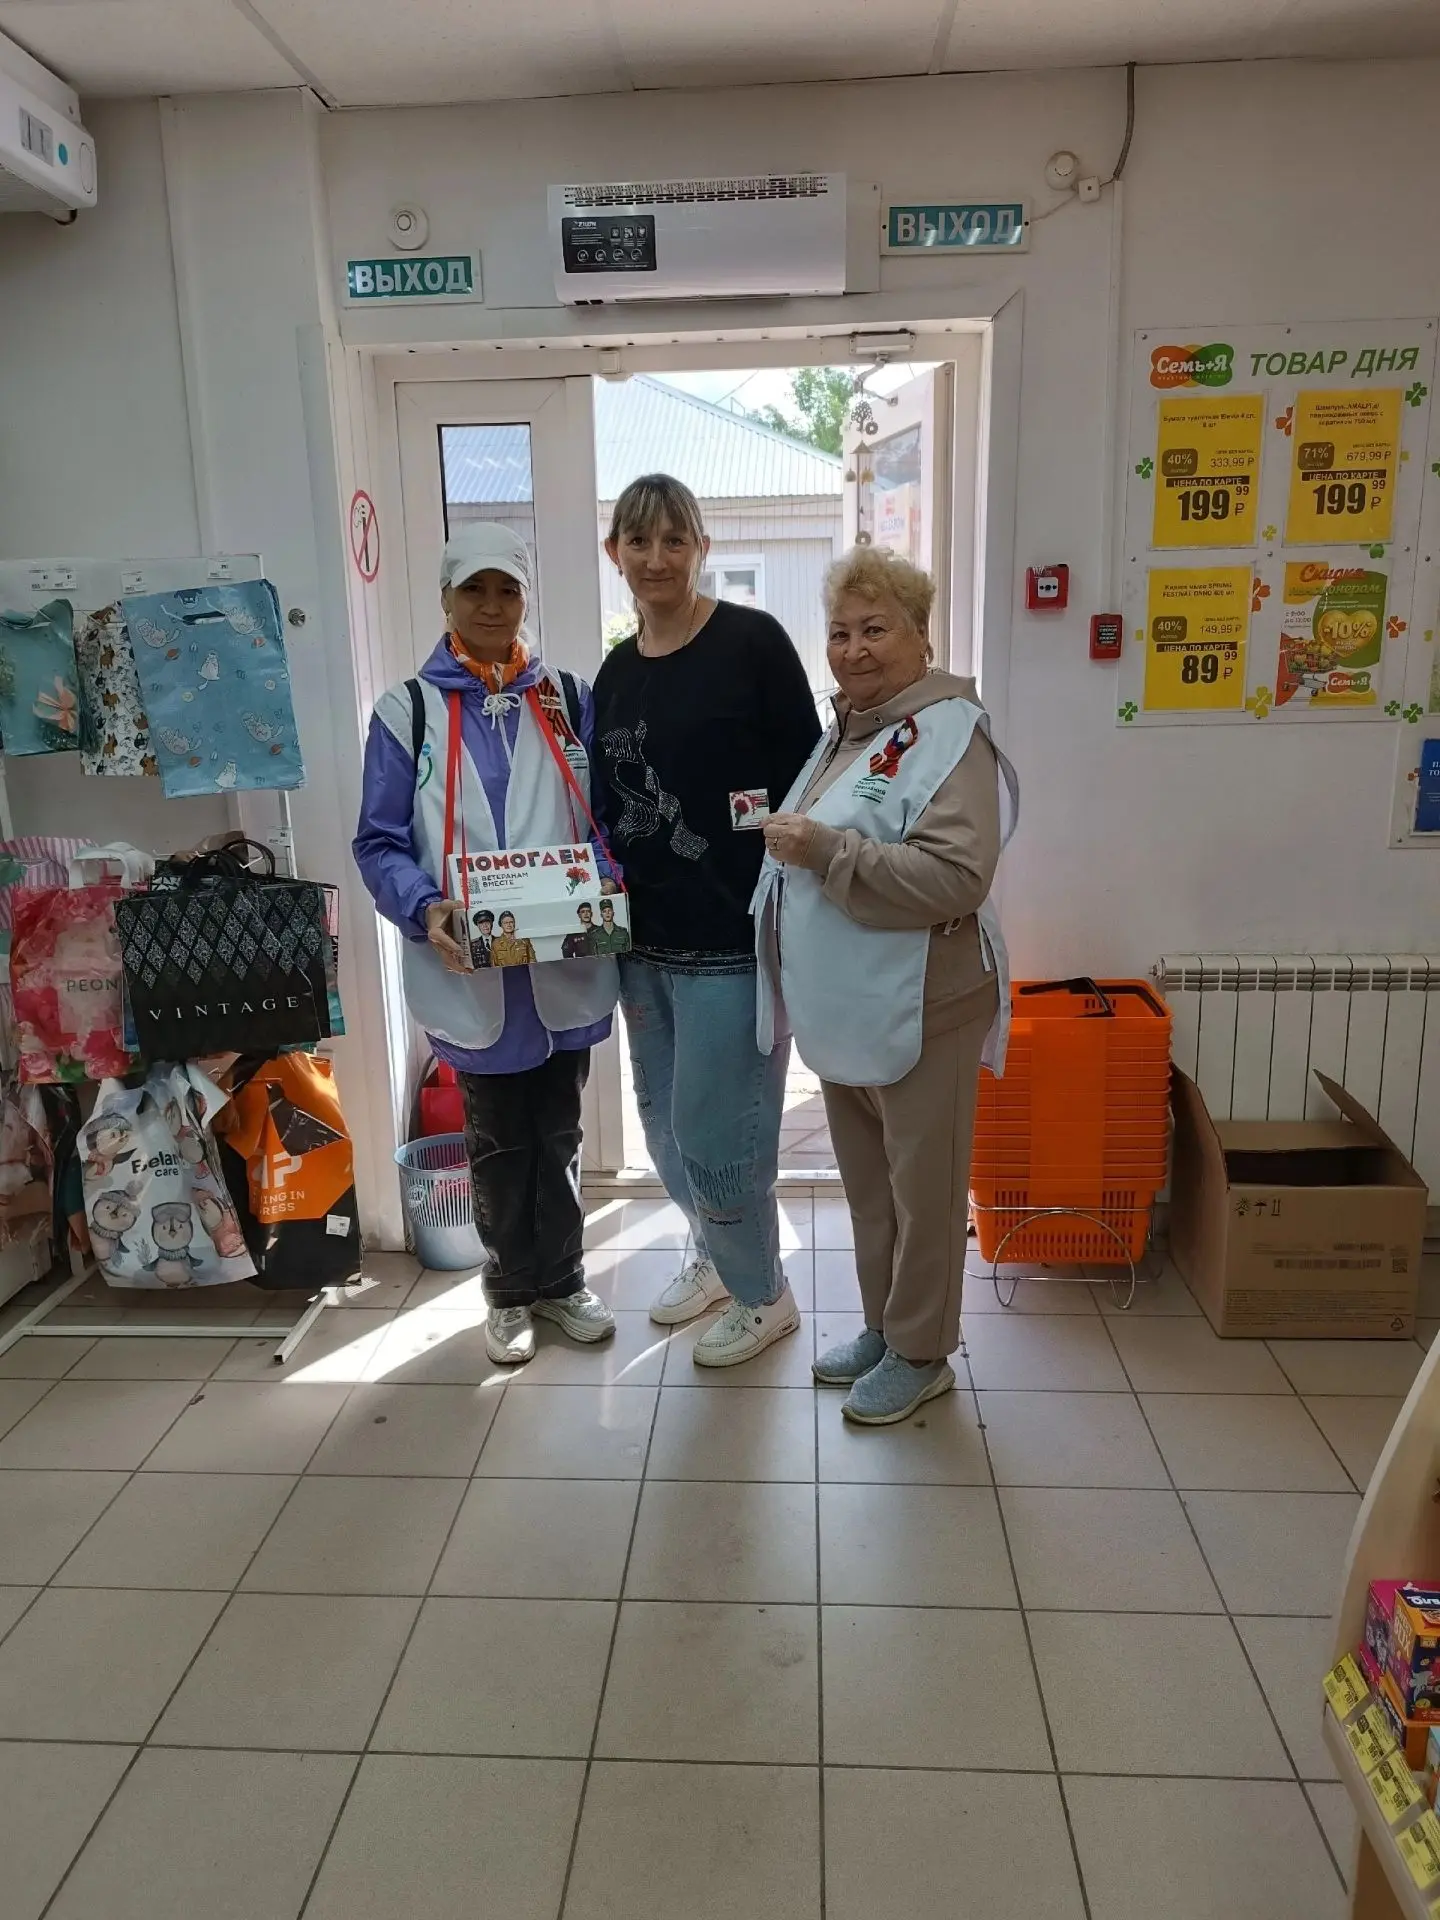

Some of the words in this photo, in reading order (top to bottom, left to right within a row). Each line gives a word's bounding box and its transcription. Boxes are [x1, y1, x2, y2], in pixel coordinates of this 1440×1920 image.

[897, 210, 1015, 242] ВЫХОД
[354, 261, 467, 294] ВЫХОД
[1157, 354, 1228, 374] Семь+Я
[1250, 351, 1347, 377] ТОВАР
[1350, 347, 1420, 378] ДНЯ
[1167, 454, 1192, 465] 40%
[1304, 447, 1329, 459] 71%
[1173, 478, 1199, 487] ЦЕНА
[1200, 478, 1213, 486] ПО
[1214, 477, 1242, 486] КАРТЕ
[1308, 472, 1334, 481] ЦЕНА
[1335, 472, 1349, 480] ПО
[1350, 471, 1378, 480] КАРТЕ
[1177, 489, 1230, 521] 199
[1235, 486, 1250, 496] 99
[1313, 483, 1367, 515] 199
[1372, 480, 1386, 490] 99
[1300, 563, 1368, 584] Скидка
[1157, 621, 1182, 631] 40%
[1323, 621, 1371, 639] -10%
[1163, 644, 1188, 652] ЦЕНА
[1203, 643, 1231, 651] КАРТЕ
[1181, 654, 1218, 684] 89
[1223, 651, 1238, 661] 99
[456, 848, 590, 873] ПОМОГАЕМ
[481, 872, 529, 882] ВЕТЕРАНАМ
[482, 880, 514, 888] ВМЕСТЕ
[150, 996, 300, 1021] VINTAGE
[154, 1168, 179, 1178] care
[290, 1190, 305, 1200] IN
[259, 1203, 296, 1216] RESS
